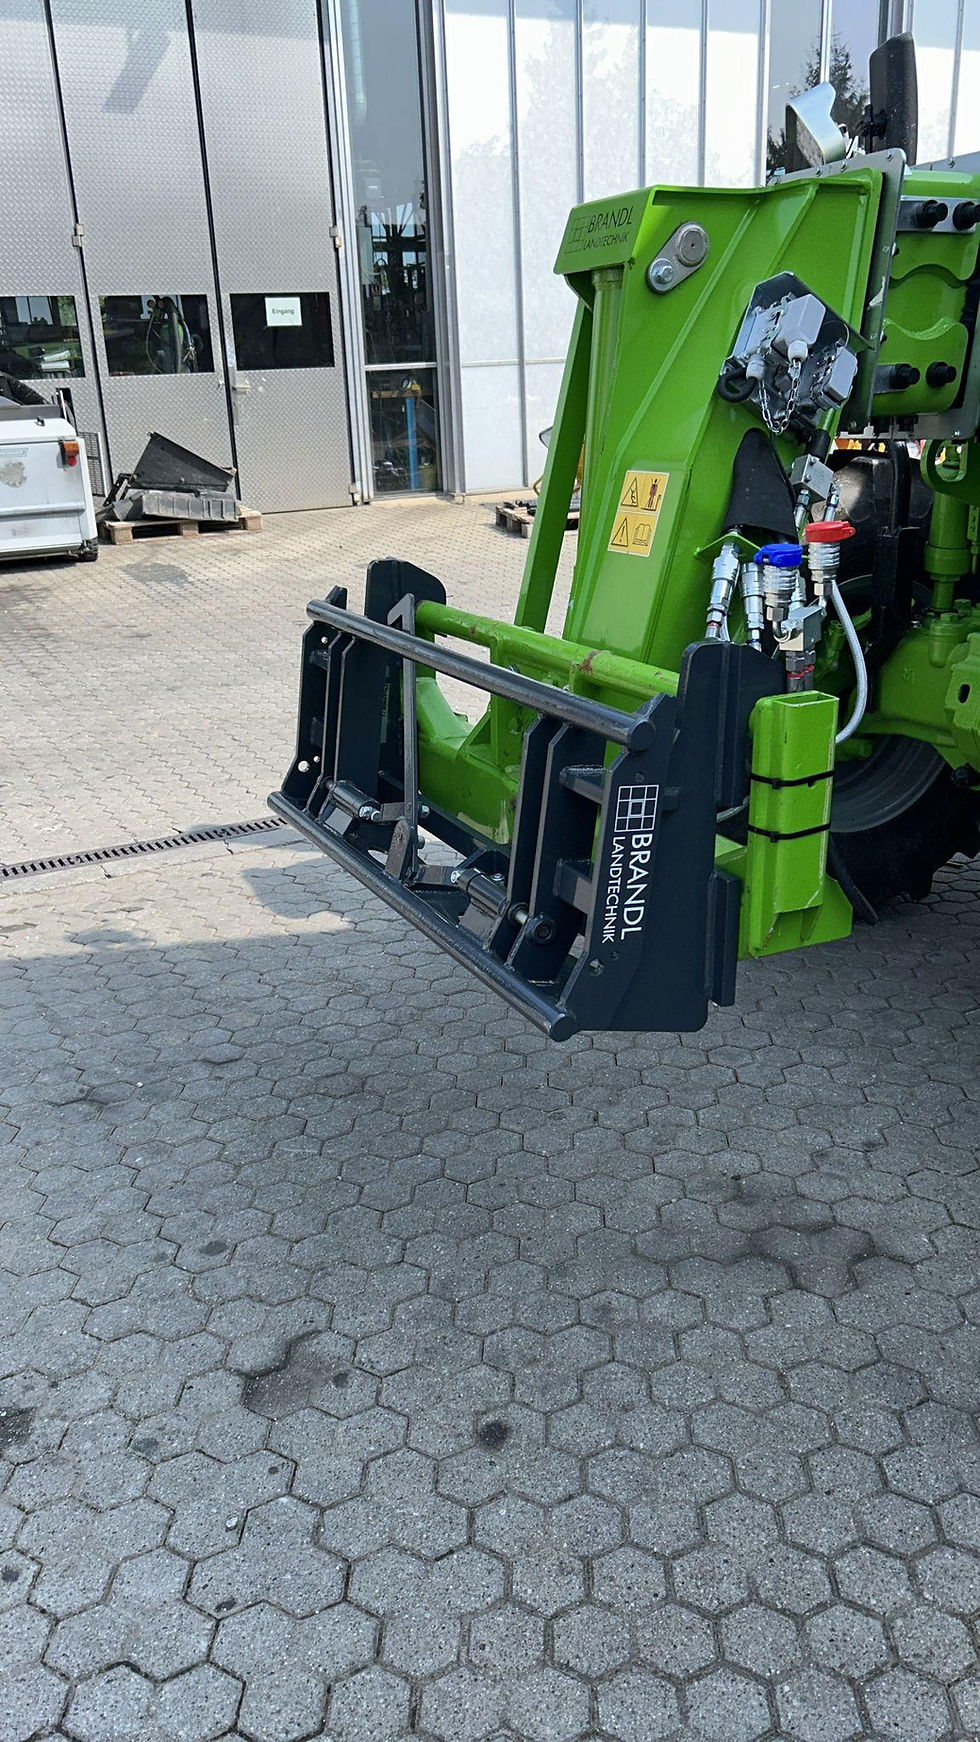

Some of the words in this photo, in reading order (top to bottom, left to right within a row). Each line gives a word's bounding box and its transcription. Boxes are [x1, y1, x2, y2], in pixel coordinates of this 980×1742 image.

[583, 231, 629, 250] LANDTECHNIK
[587, 206, 634, 233] BRANDL
[602, 836, 626, 944] LANDTECHNIK
[620, 833, 653, 940] BRANDL
